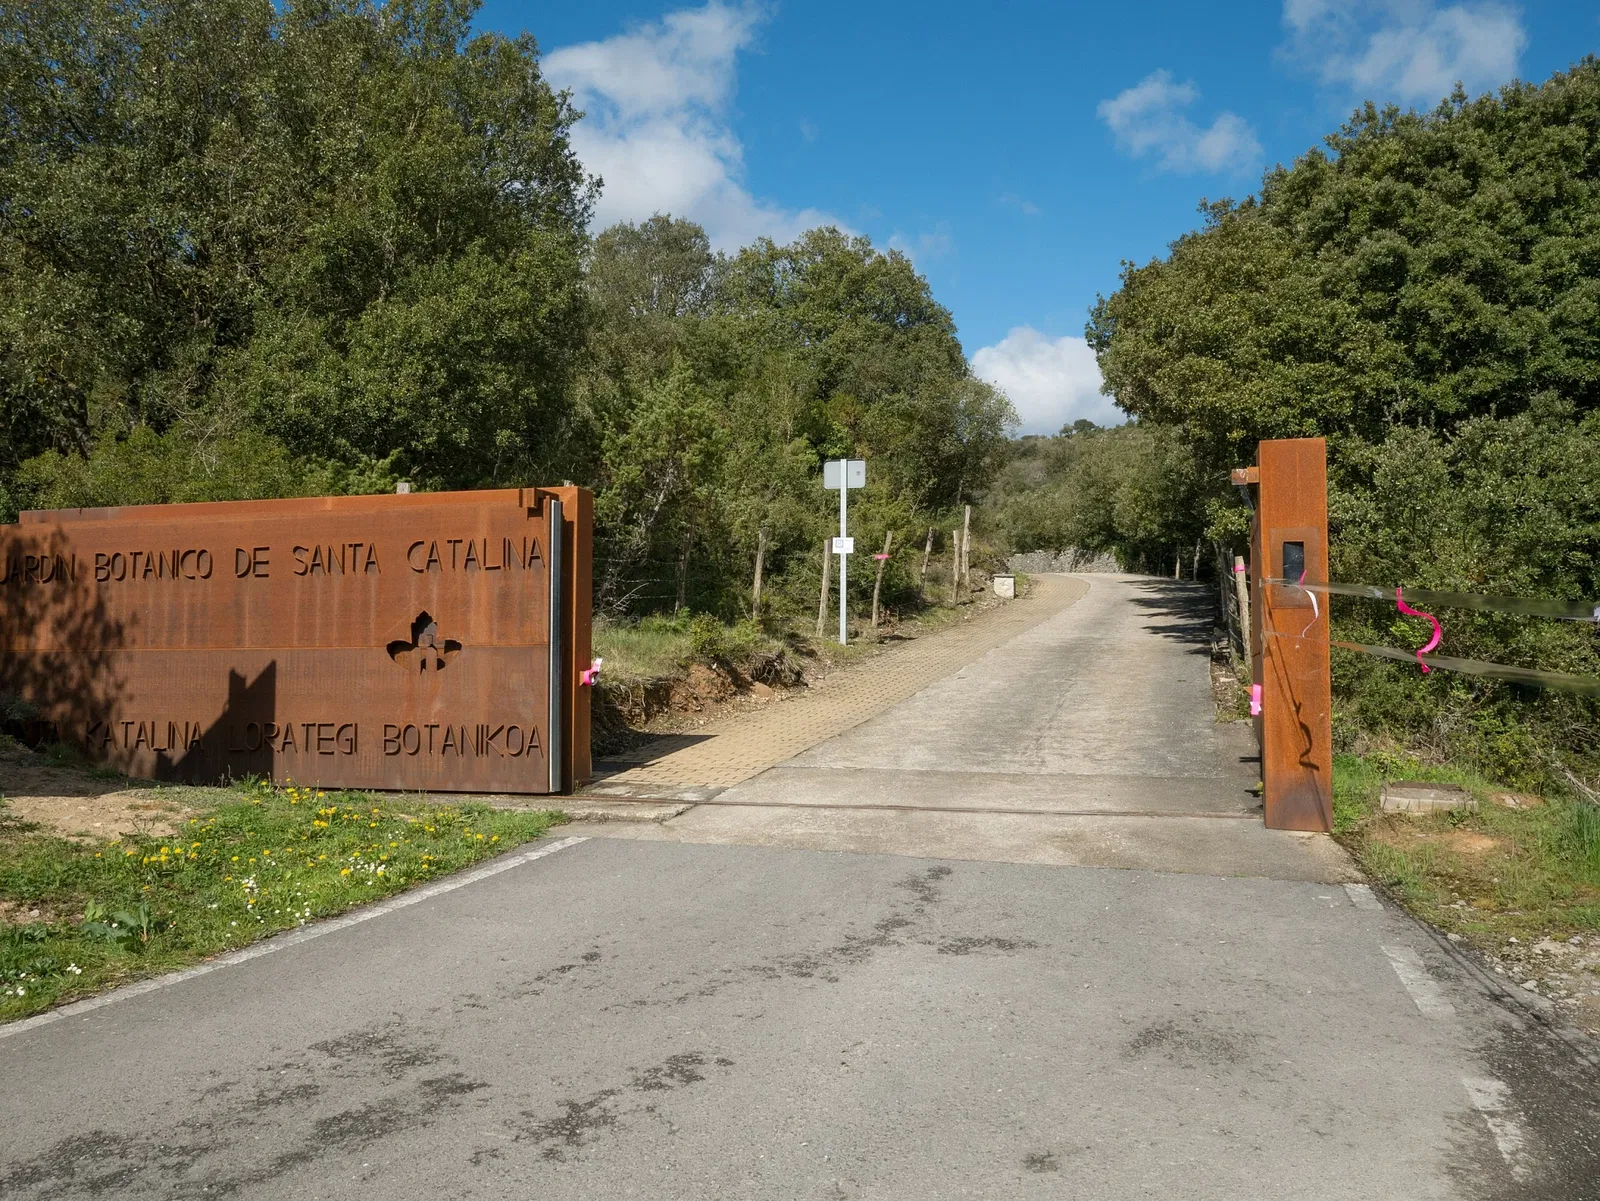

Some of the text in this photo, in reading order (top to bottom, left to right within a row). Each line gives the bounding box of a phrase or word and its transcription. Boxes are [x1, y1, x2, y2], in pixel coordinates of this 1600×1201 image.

[0, 536, 546, 585] JARDIN BOTANICO DE SANTA CATALINA
[86, 720, 204, 752] KATALINA
[228, 721, 358, 755] LORATEGI
[383, 723, 544, 758] BOTANIKOA
